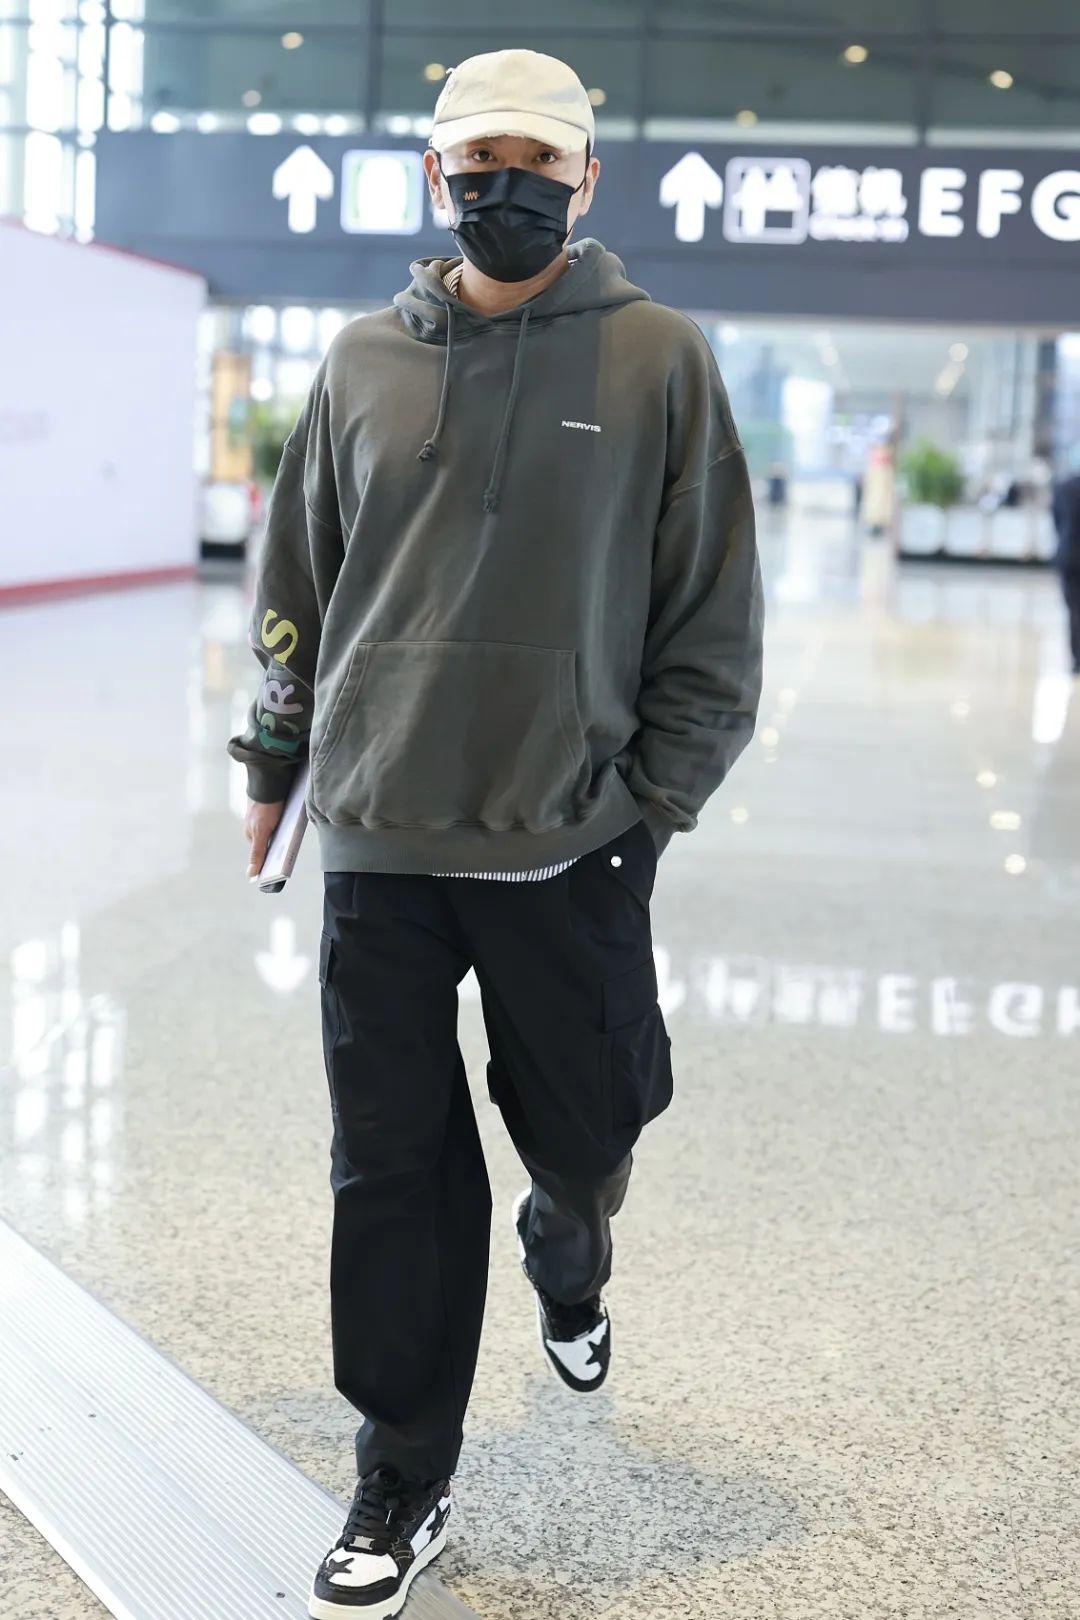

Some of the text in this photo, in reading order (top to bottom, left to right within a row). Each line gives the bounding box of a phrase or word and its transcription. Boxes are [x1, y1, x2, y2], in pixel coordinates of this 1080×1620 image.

[918, 167, 967, 237] E
[976, 168, 1024, 239] F
[1031, 170, 1080, 241] G
[561, 420, 601, 432] NERVIS
